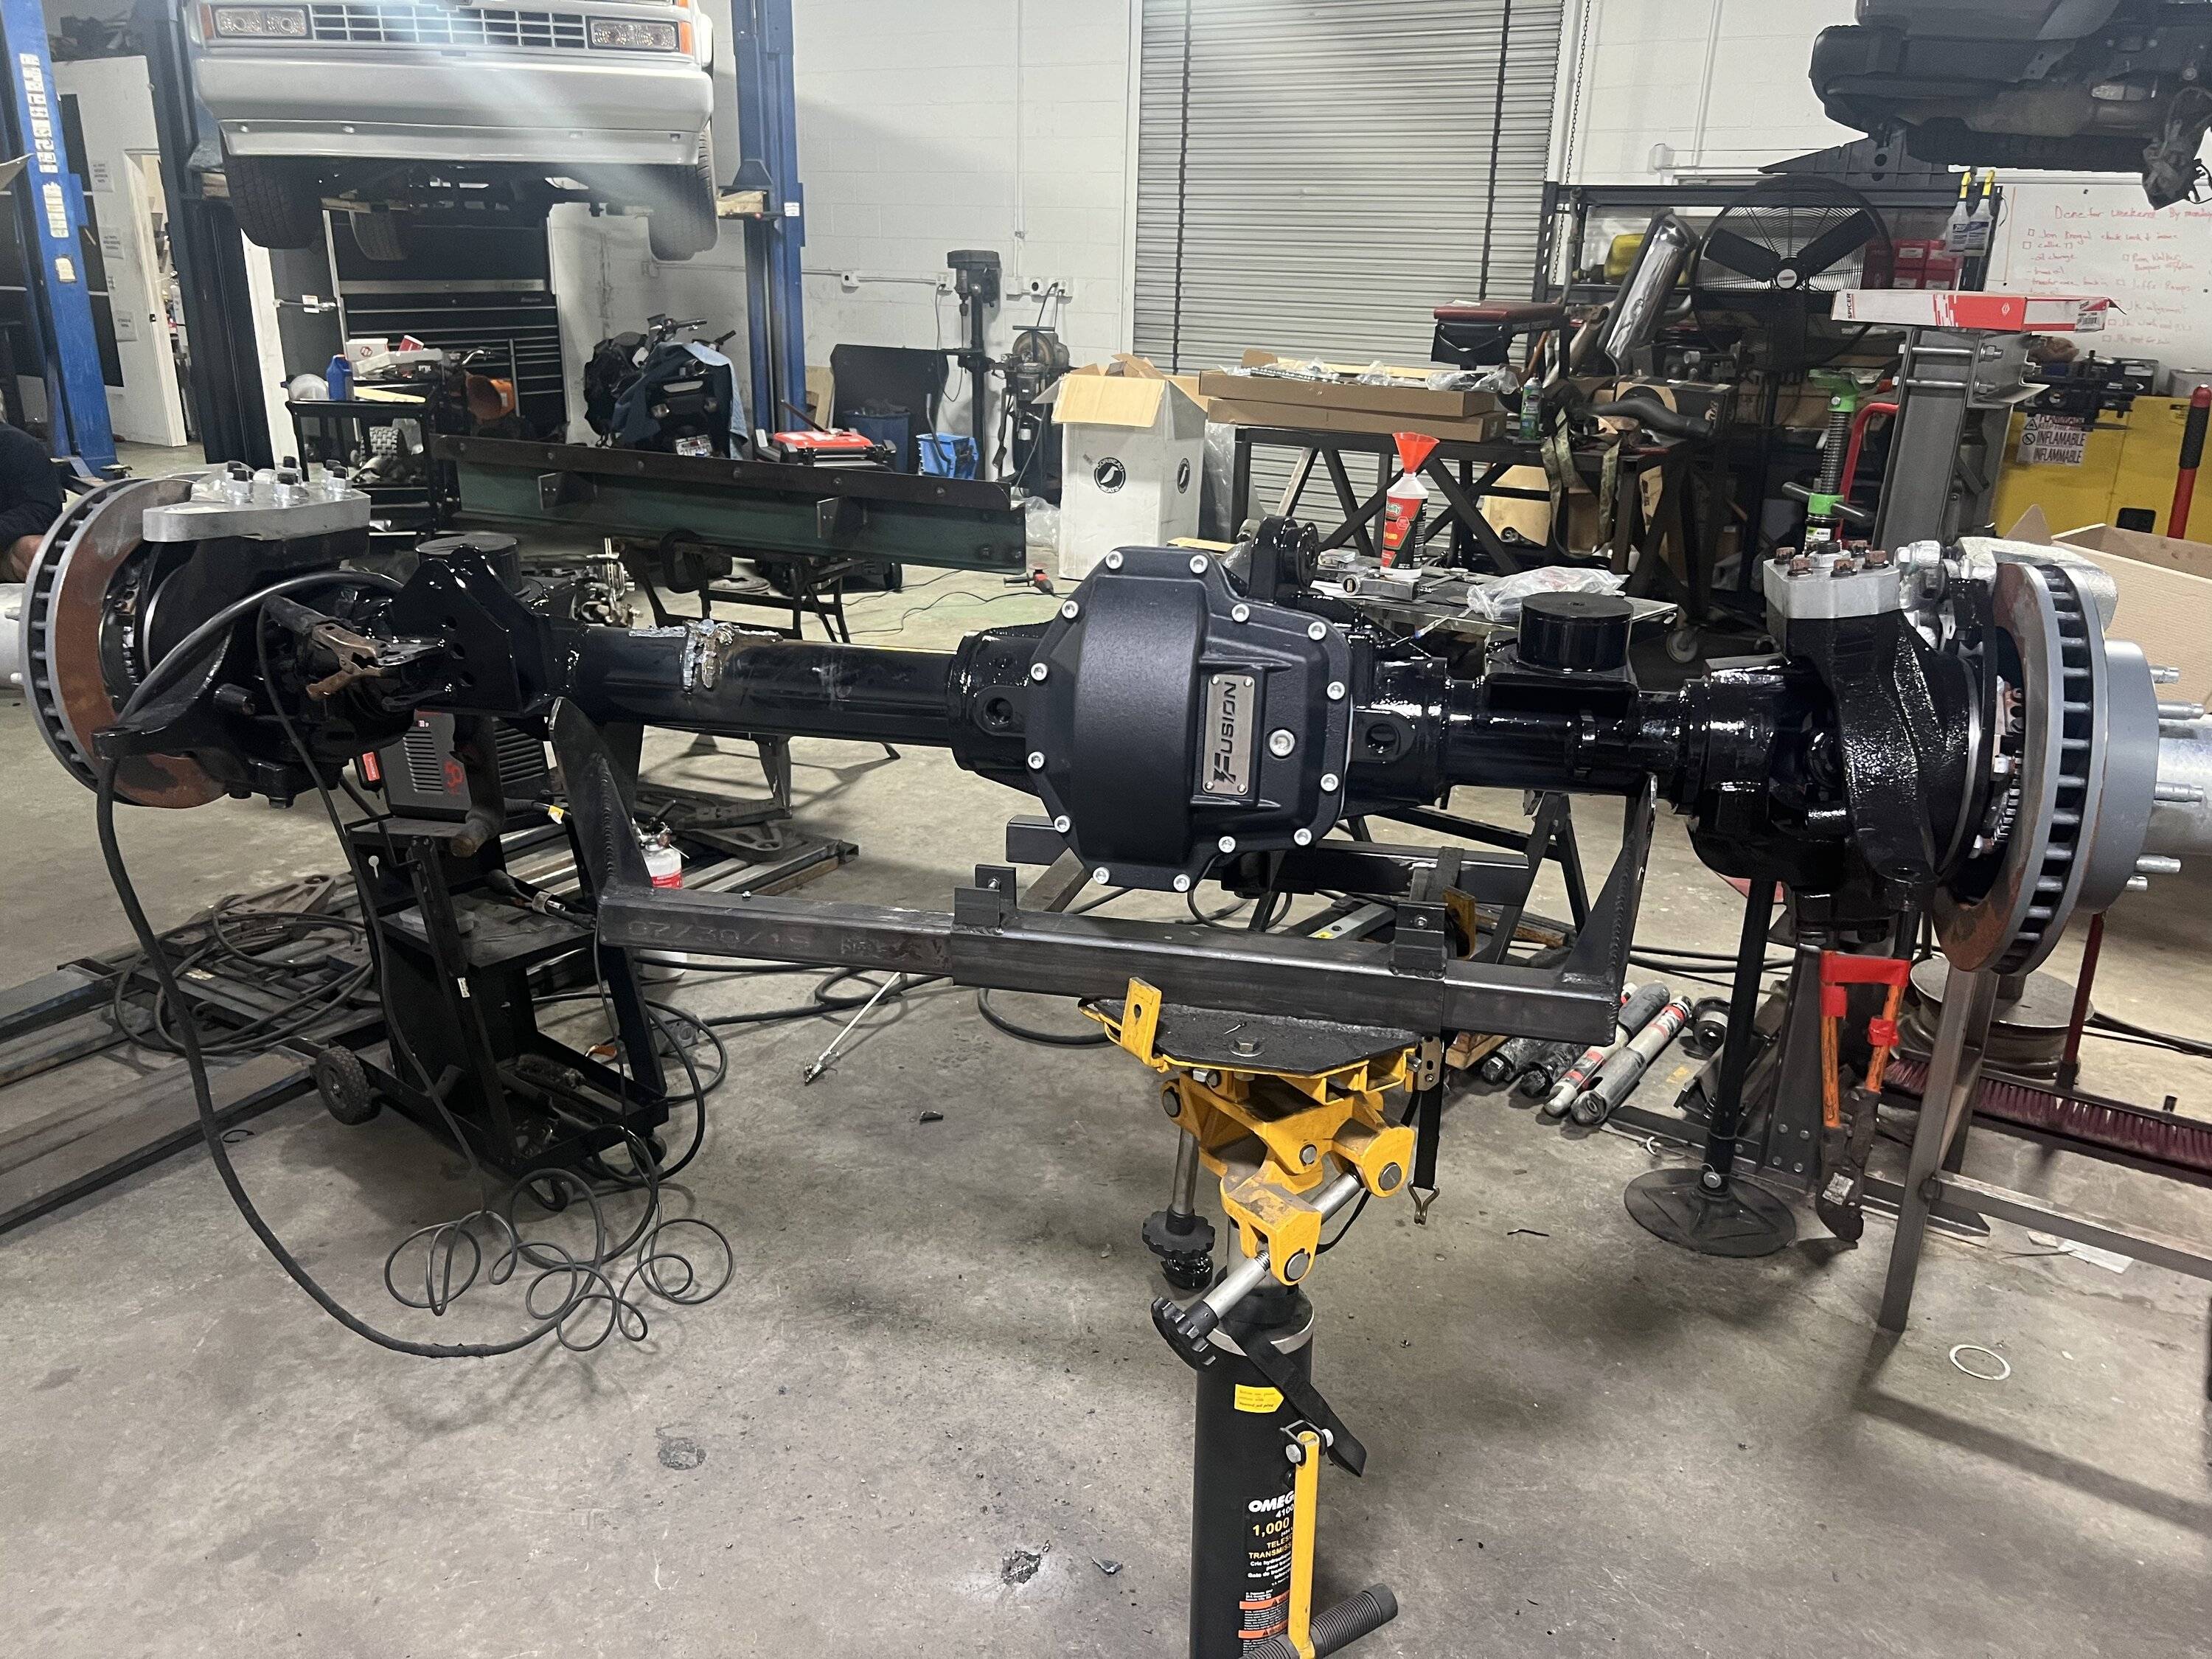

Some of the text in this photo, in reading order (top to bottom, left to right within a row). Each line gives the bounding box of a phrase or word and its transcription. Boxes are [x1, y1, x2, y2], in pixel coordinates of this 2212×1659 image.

[2037, 431, 2086, 446] INFLAMABLE
[1214, 681, 1237, 784] FUSION
[1248, 1490, 1294, 1512] OMEG
[1276, 1504, 1294, 1517] 4100
[1253, 1517, 1290, 1537] 1,000
[1267, 1534, 1292, 1549] TELESC
[1248, 1542, 1292, 1559] TRANSMISS
